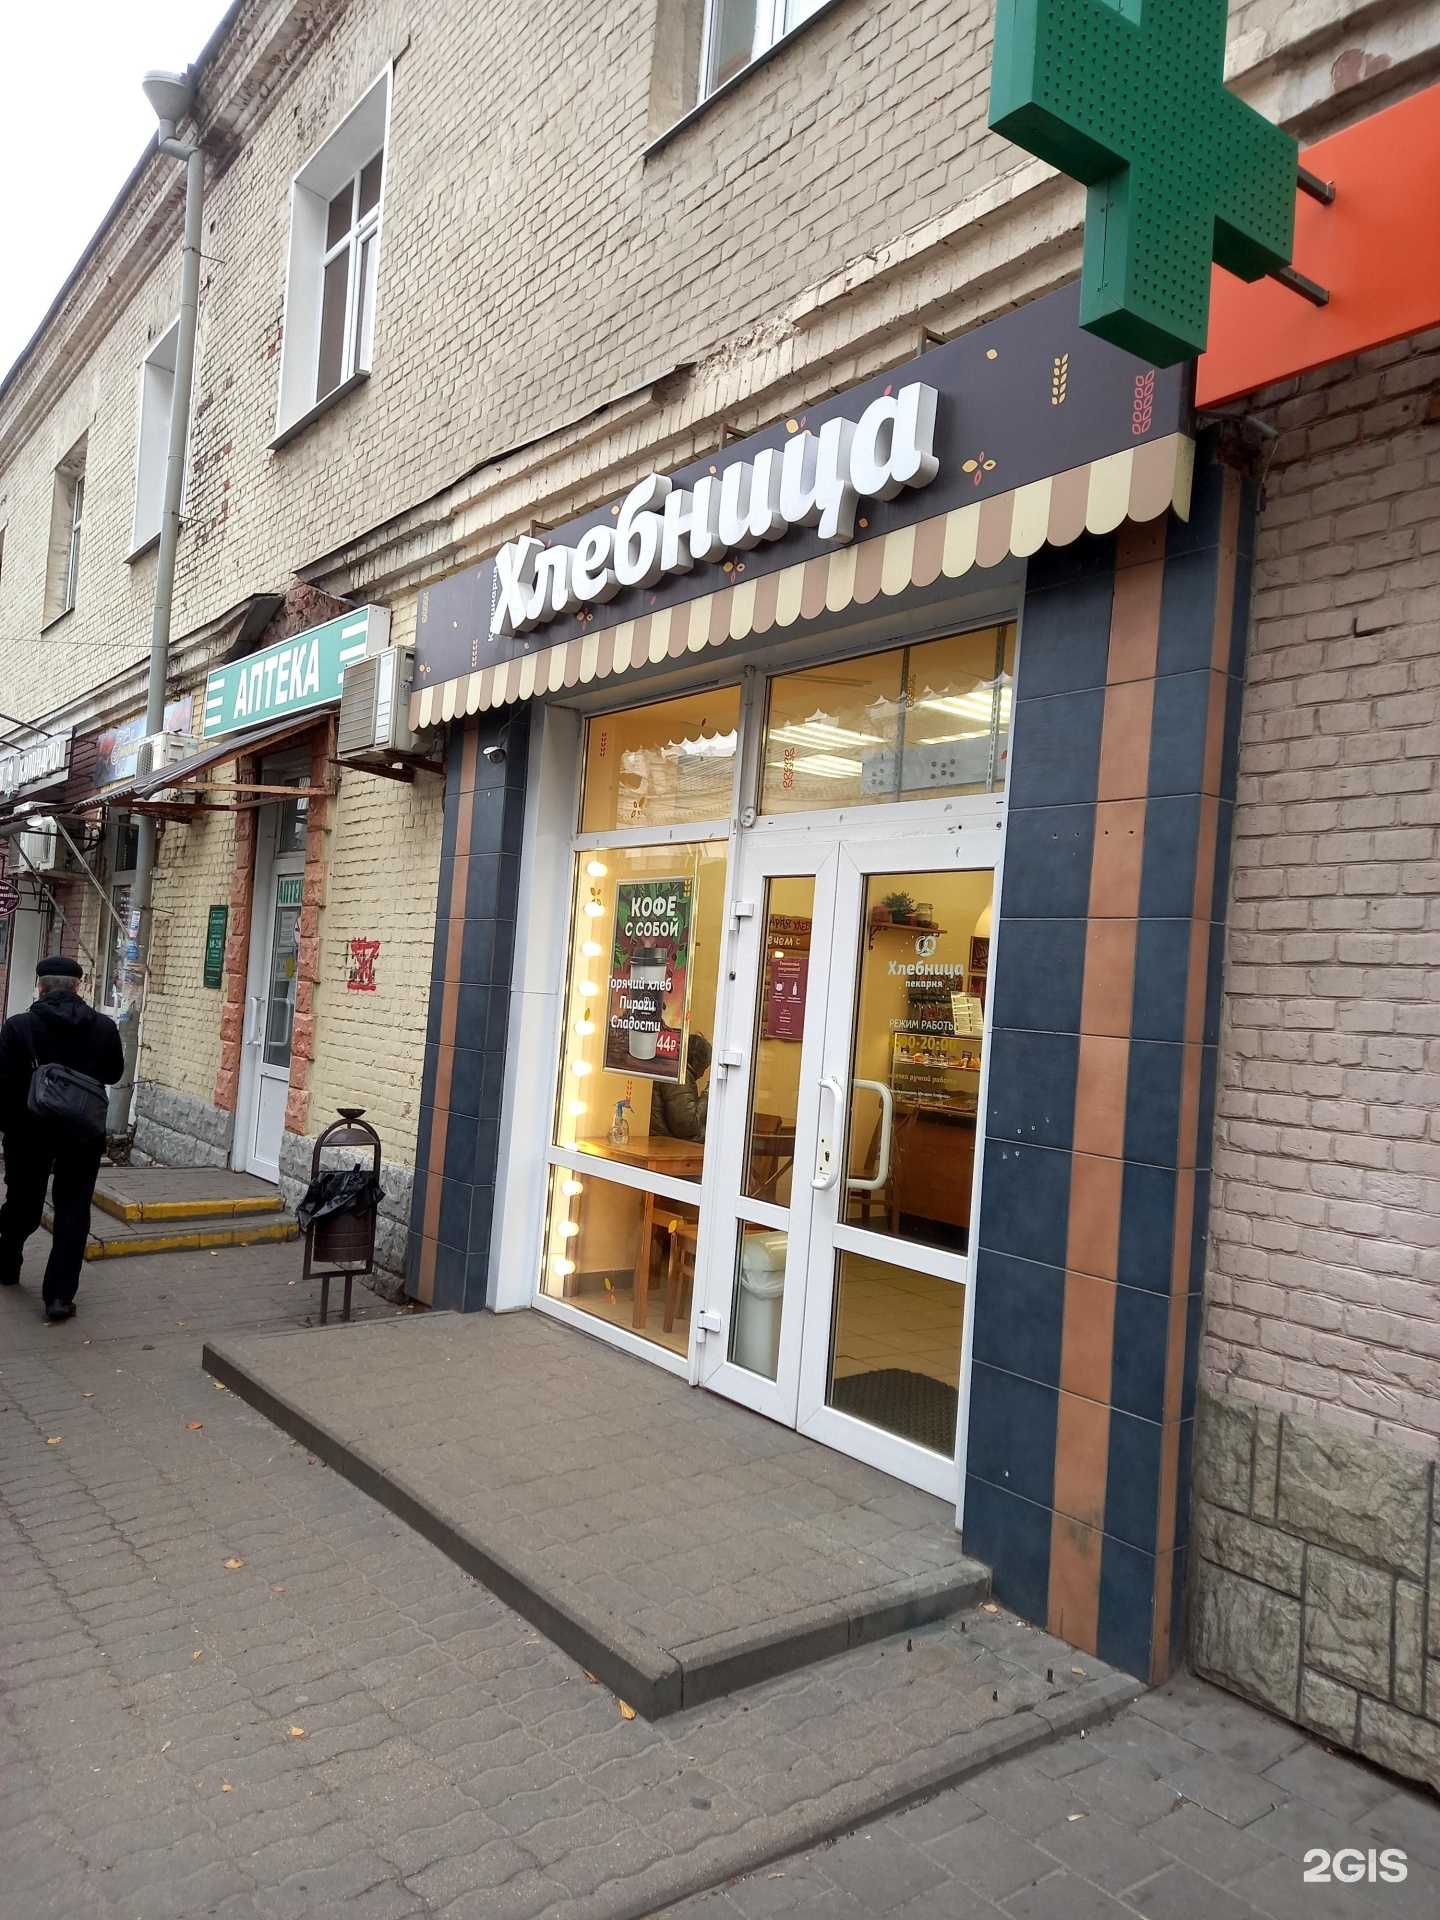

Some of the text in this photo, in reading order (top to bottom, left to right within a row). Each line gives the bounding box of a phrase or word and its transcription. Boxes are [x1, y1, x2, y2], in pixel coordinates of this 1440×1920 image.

[491, 381, 938, 639] Хлебница
[233, 638, 320, 719] АПТЕКА
[631, 895, 677, 917] КОФЕ
[625, 917, 679, 937] С СОБОЙ
[887, 960, 964, 978] Хлебница
[647, 977, 672, 992] хлеб
[905, 980, 943, 990] пекарня
[620, 995, 656, 1014] Пироги
[611, 1015, 661, 1032] Сладости
[889, 1019, 919, 1030] РЕЖИМ
